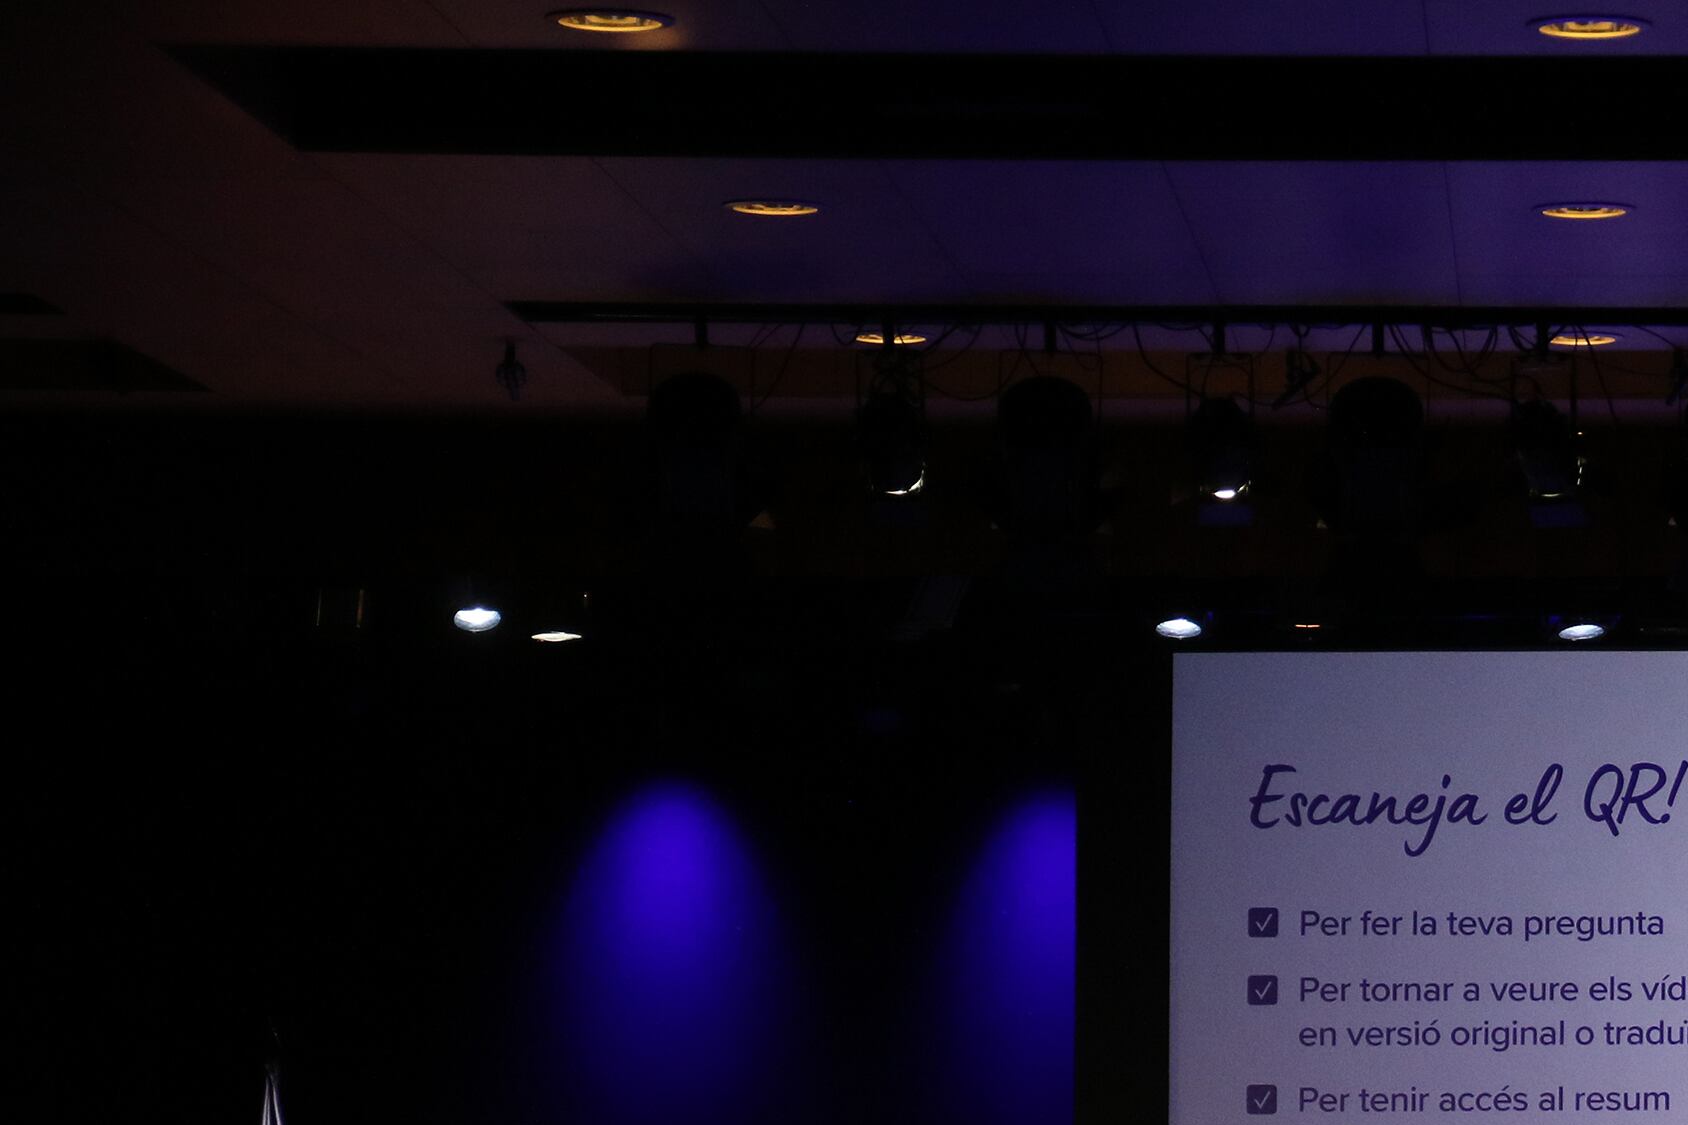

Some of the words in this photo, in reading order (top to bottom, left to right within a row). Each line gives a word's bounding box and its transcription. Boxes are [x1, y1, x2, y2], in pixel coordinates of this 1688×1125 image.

[1248, 763, 1488, 858] Escaneja
[1504, 763, 1564, 826] el
[1300, 910, 1352, 937] Per
[1360, 910, 1403, 937] fer
[1412, 910, 1437, 936] la
[1446, 911, 1513, 936] teva
[1524, 911, 1664, 942] pregunta
[1299, 976, 1352, 1003] Per
[1359, 978, 1454, 1003] tornar
[1462, 982, 1480, 1002] a
[1490, 982, 1579, 1002] veure
[1588, 975, 1633, 1002] els
[1298, 1026, 1337, 1047] en
[1346, 1019, 1441, 1047] versió
[1450, 1020, 1565, 1053] original
[1575, 1025, 1595, 1046] o
[1299, 1086, 1350, 1113] Per
[1358, 1086, 1430, 1113] tenir
[1438, 1085, 1529, 1113] accés
[1538, 1085, 1564, 1112] al
[1575, 1091, 1670, 1112] resum
